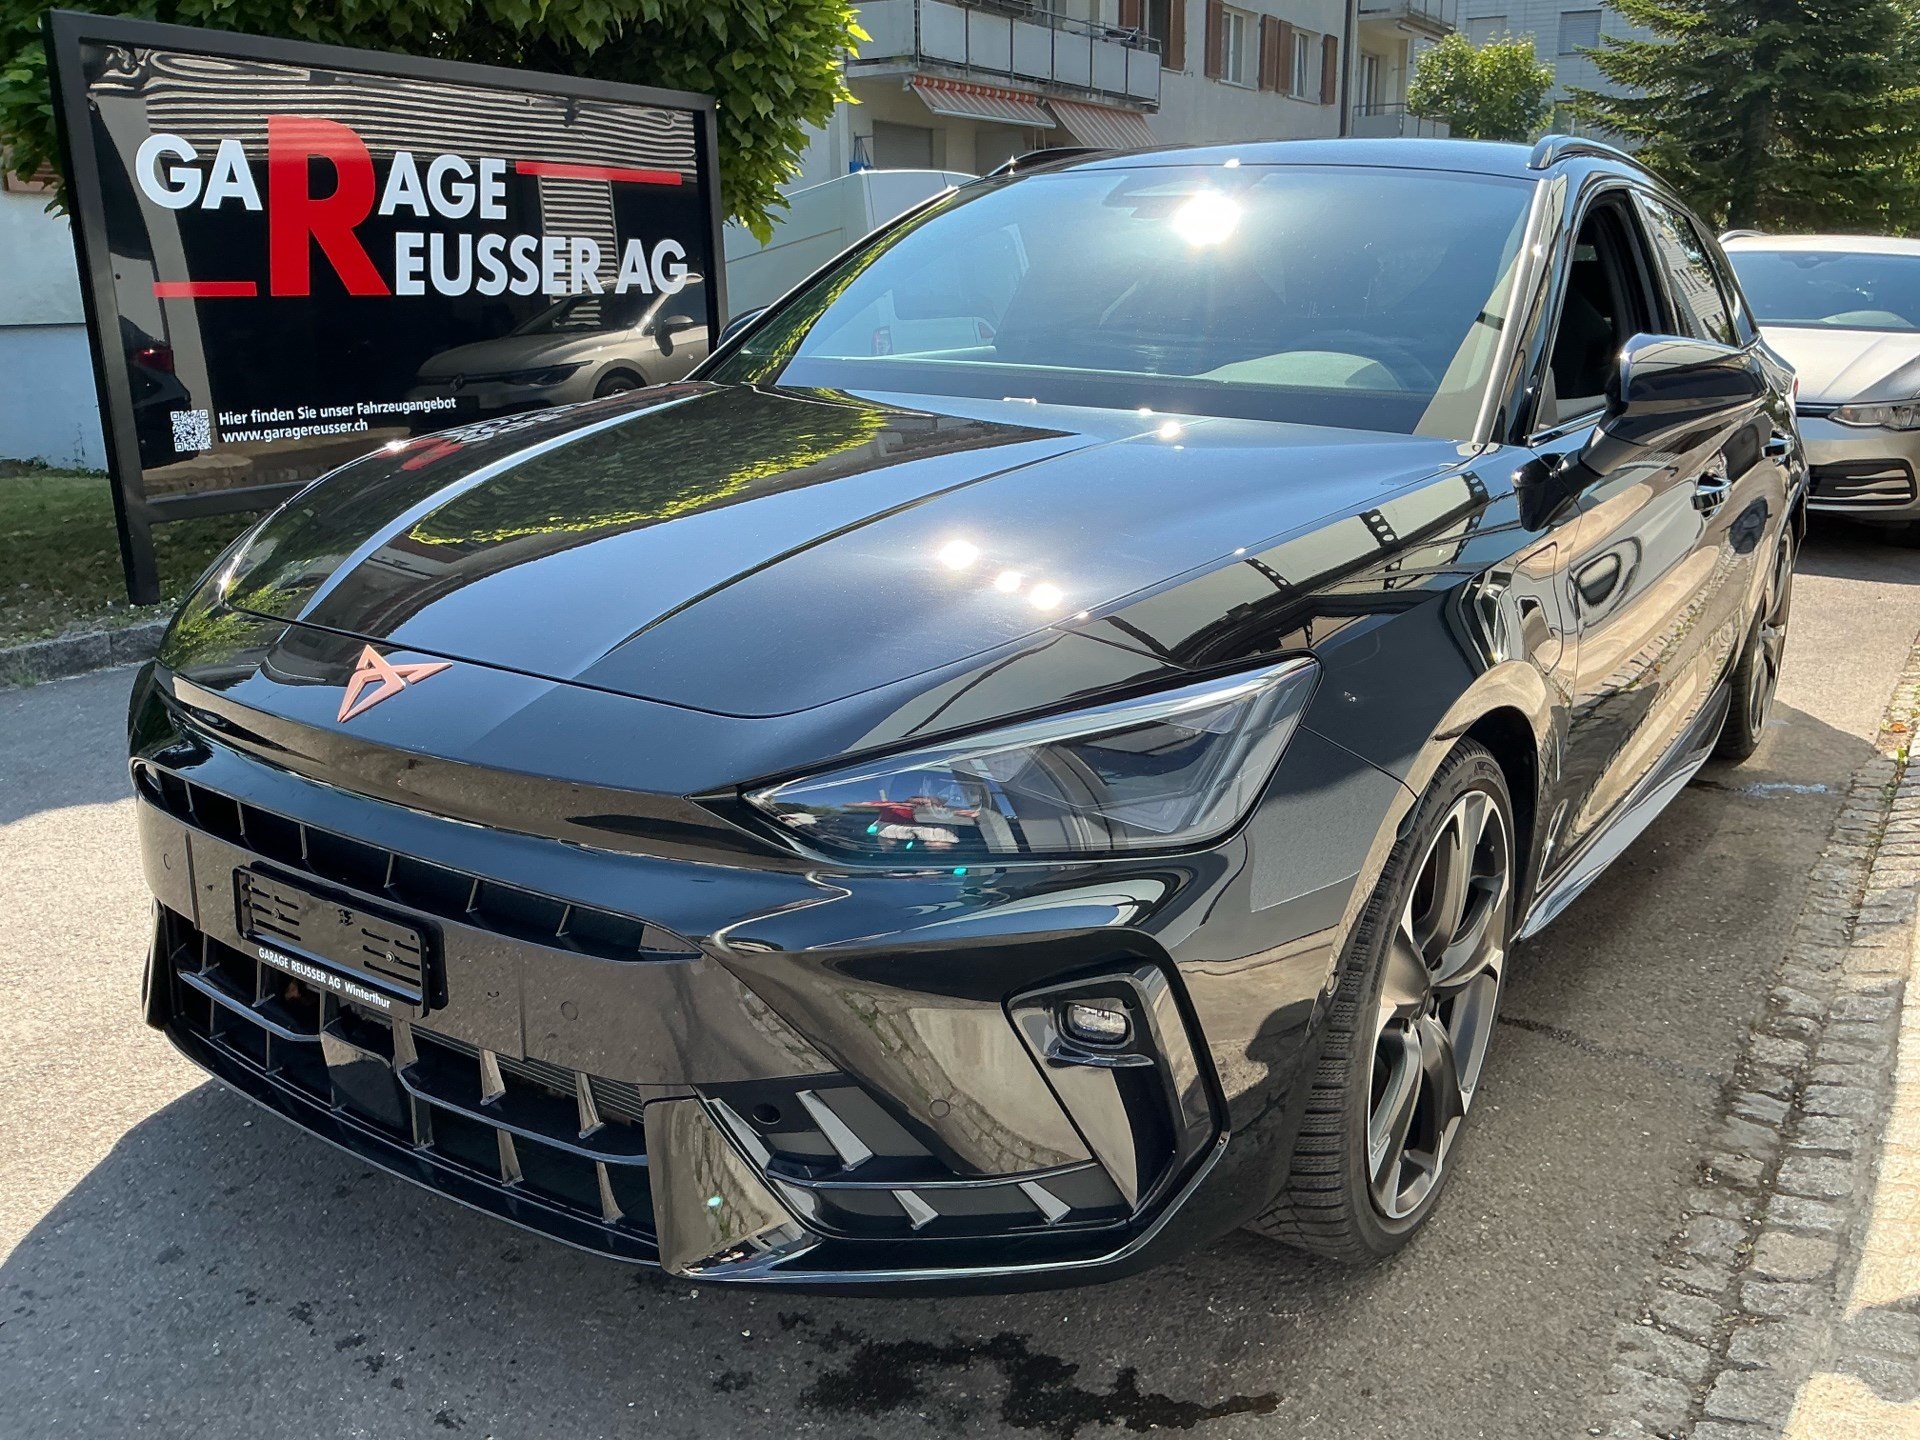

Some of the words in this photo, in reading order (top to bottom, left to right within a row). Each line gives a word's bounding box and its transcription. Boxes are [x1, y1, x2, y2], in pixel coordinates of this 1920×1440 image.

[135, 114, 507, 296] GARAGE
[614, 239, 688, 295] AG
[218, 411, 248, 426] Hier
[251, 408, 294, 424] finden
[298, 406, 317, 420] Sie
[320, 405, 354, 419] unser
[357, 397, 457, 416] Fahrzeugangebot
[221, 419, 368, 443] www.garagereusser.ch
[258, 947, 289, 969] GARAGE
[291, 960, 327, 984] REUSSER
[328, 976, 341, 989] AG
[344, 981, 391, 1009] Winterthur
